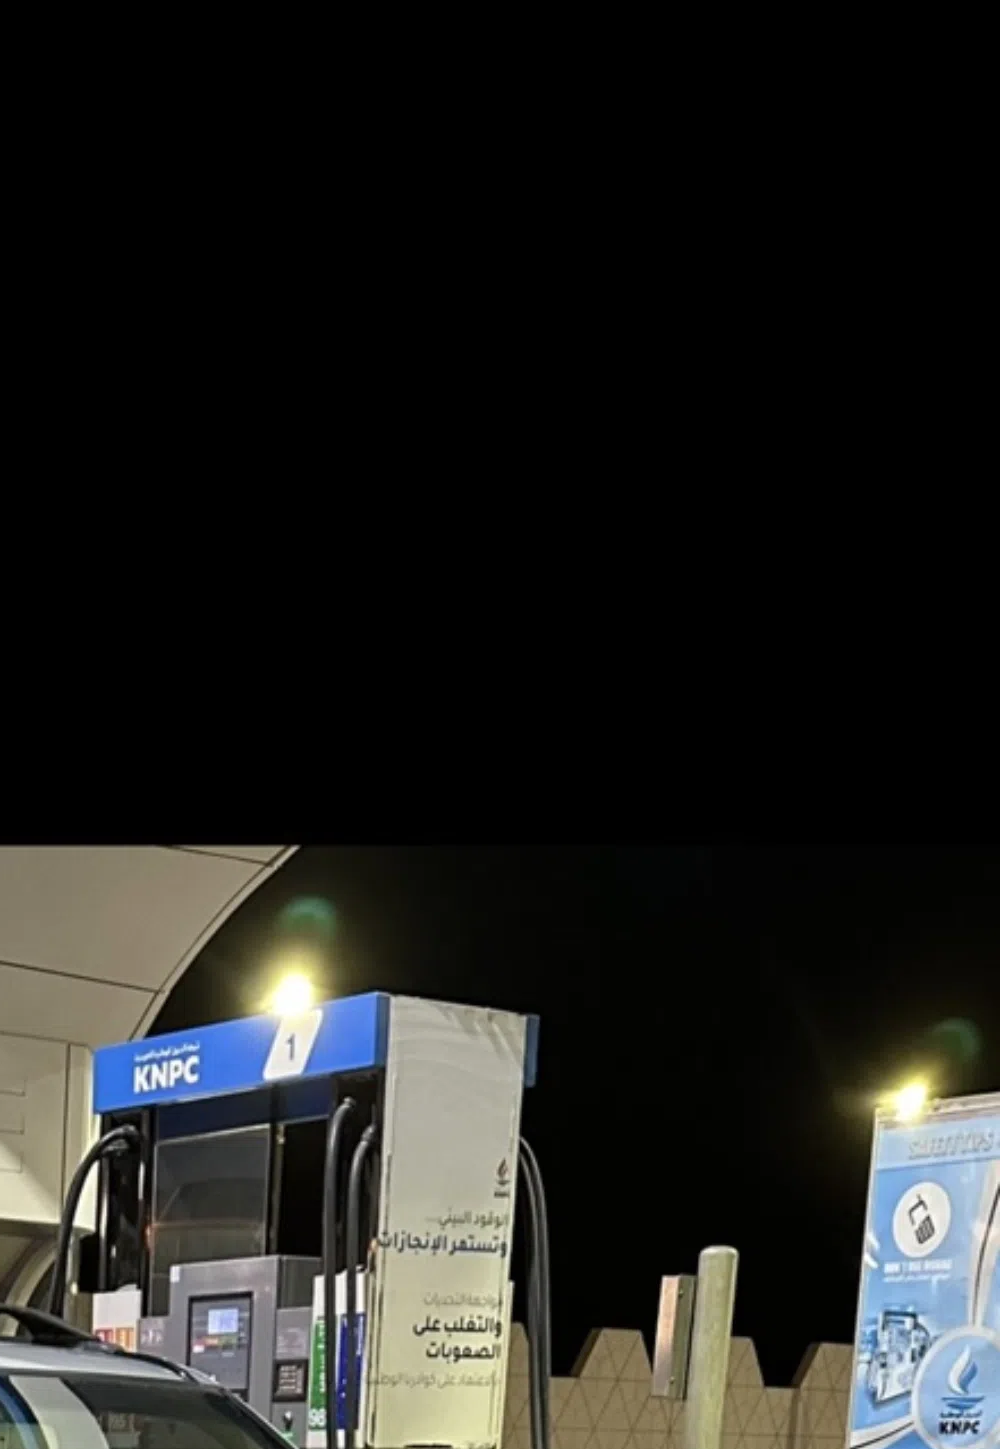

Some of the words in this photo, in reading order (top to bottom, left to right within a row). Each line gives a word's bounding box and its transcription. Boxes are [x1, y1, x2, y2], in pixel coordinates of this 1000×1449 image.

[286, 1033, 296, 1061] 1
[133, 1055, 199, 1095] KNPC
[449, 1234, 507, 1258] وتستمر
[412, 1315, 441, 1337] على
[443, 1314, 502, 1338] والتغلب
[426, 1341, 500, 1364] الصعوبات
[939, 1420, 980, 1435] KNPC
